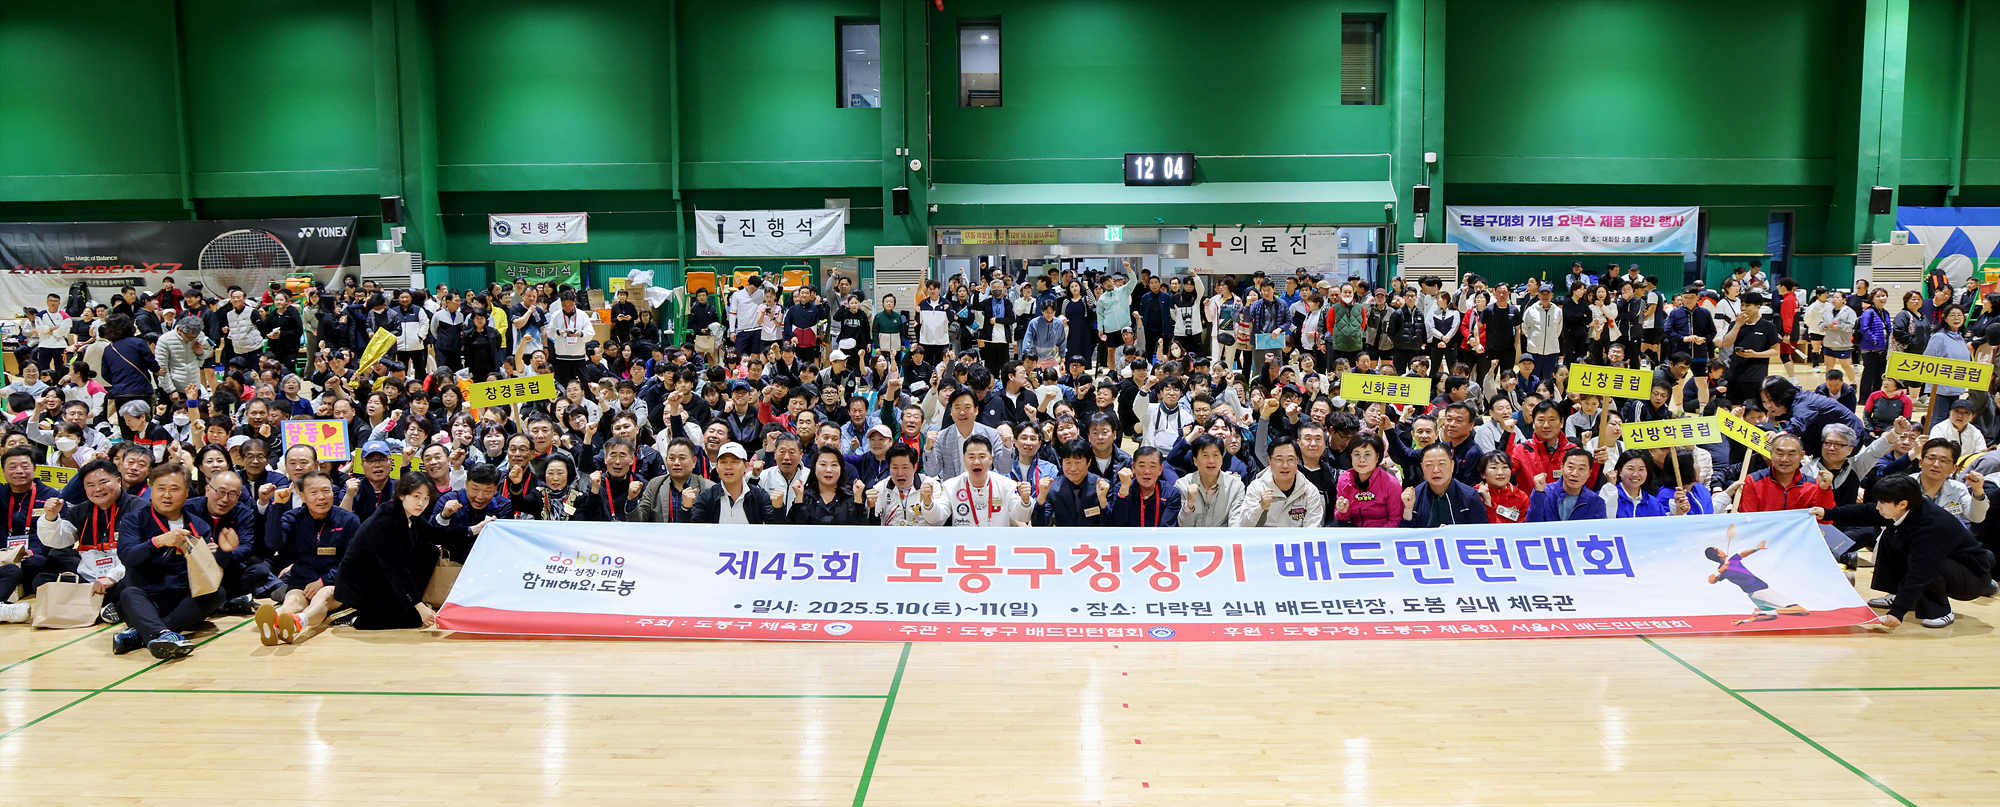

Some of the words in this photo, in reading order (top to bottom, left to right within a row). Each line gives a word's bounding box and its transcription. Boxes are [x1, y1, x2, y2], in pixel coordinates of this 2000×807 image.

[1134, 156, 1154, 180] 12
[1163, 156, 1184, 180] 04
[1460, 214, 1524, 227] 도봉구대회
[1528, 215, 1554, 227] 기념
[1557, 214, 1596, 227] 요넥스
[1599, 215, 1626, 227] 제품
[1629, 215, 1655, 227] 할인
[1658, 215, 1685, 227] 행사
[316, 226, 347, 238] YONEX
[505, 265, 531, 278] 심판
[534, 265, 572, 278] 대기석
[1896, 358, 1983, 384] 스카이콕클럽
[485, 381, 540, 401] 창경클럽
[1361, 379, 1411, 398] 신화클럽
[1580, 371, 1641, 392] 신창클럽
[285, 422, 319, 444] 창동
[1630, 421, 1712, 444] 신방학클럽
[549, 550, 626, 569] dobong
[714, 550, 860, 584] 제45회
[886, 543, 1246, 595] 도봉구청장기
[1274, 534, 1637, 586] 배드민턴대회
[522, 571, 596, 592] 함께해요!
[596, 579, 636, 597] 도봉
[752, 599, 798, 614] 일시:
[1086, 601, 1136, 617] 장소:
[1146, 601, 1213, 617] 다락원
[1222, 601, 1266, 617] 실내
[1275, 598, 1394, 616] 배드민턴장,
[1402, 597, 1446, 613] 도봉
[1456, 596, 1500, 613] 실내
[1508, 595, 1577, 612] 체육관
[693, 618, 754, 630] 도봉구
[759, 620, 819, 632] 체육회
[959, 625, 1019, 637] 도봉구
[1025, 626, 1144, 639] 배드민턴협회
[1374, 625, 1433, 637] 도봉구
[1511, 622, 1571, 633] 서울시
[1572, 619, 1693, 631] 배드민턴협회
